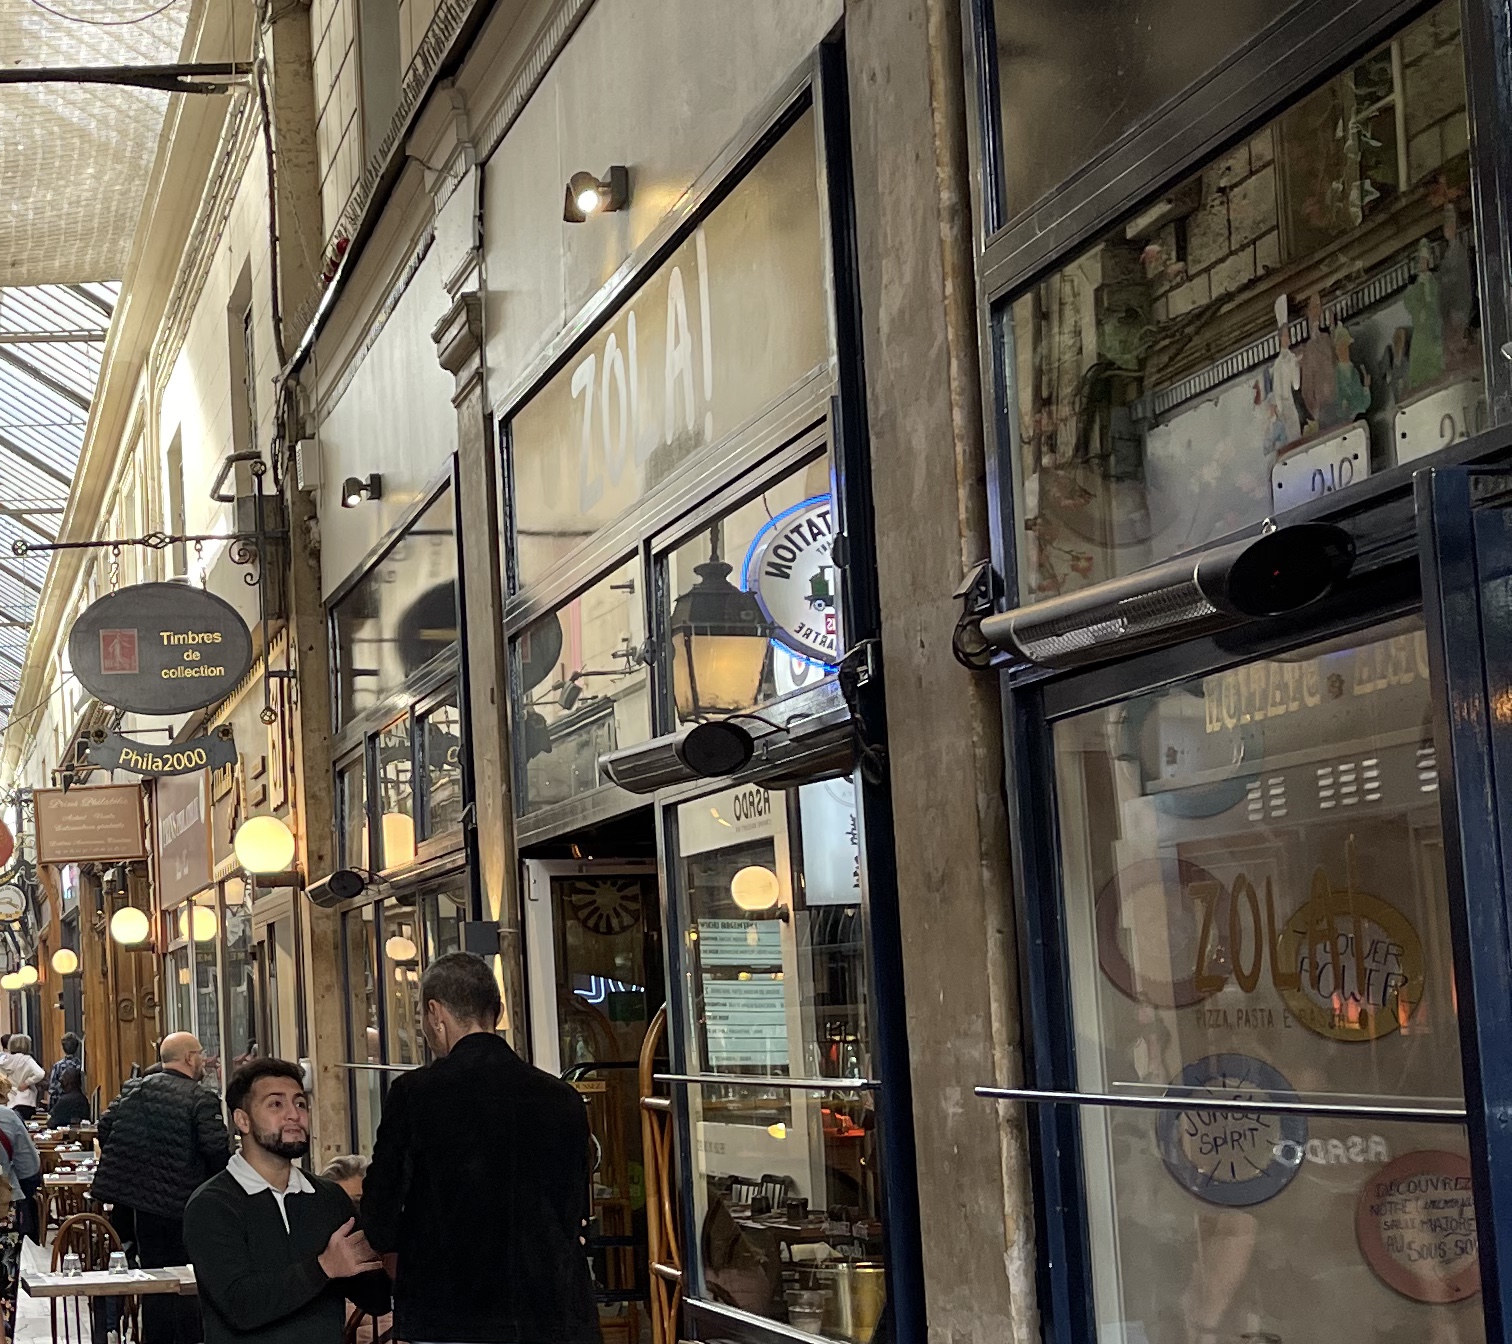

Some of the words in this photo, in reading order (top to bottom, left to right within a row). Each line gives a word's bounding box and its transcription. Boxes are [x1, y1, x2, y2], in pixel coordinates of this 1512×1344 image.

[159, 630, 222, 645] Timbres
[183, 649, 201, 661] de
[161, 665, 225, 679] collection
[119, 747, 207, 771] Phila2000
[1236, 1007, 1275, 1029] PASTA
[1199, 1125, 1259, 1156] SPIRIT
